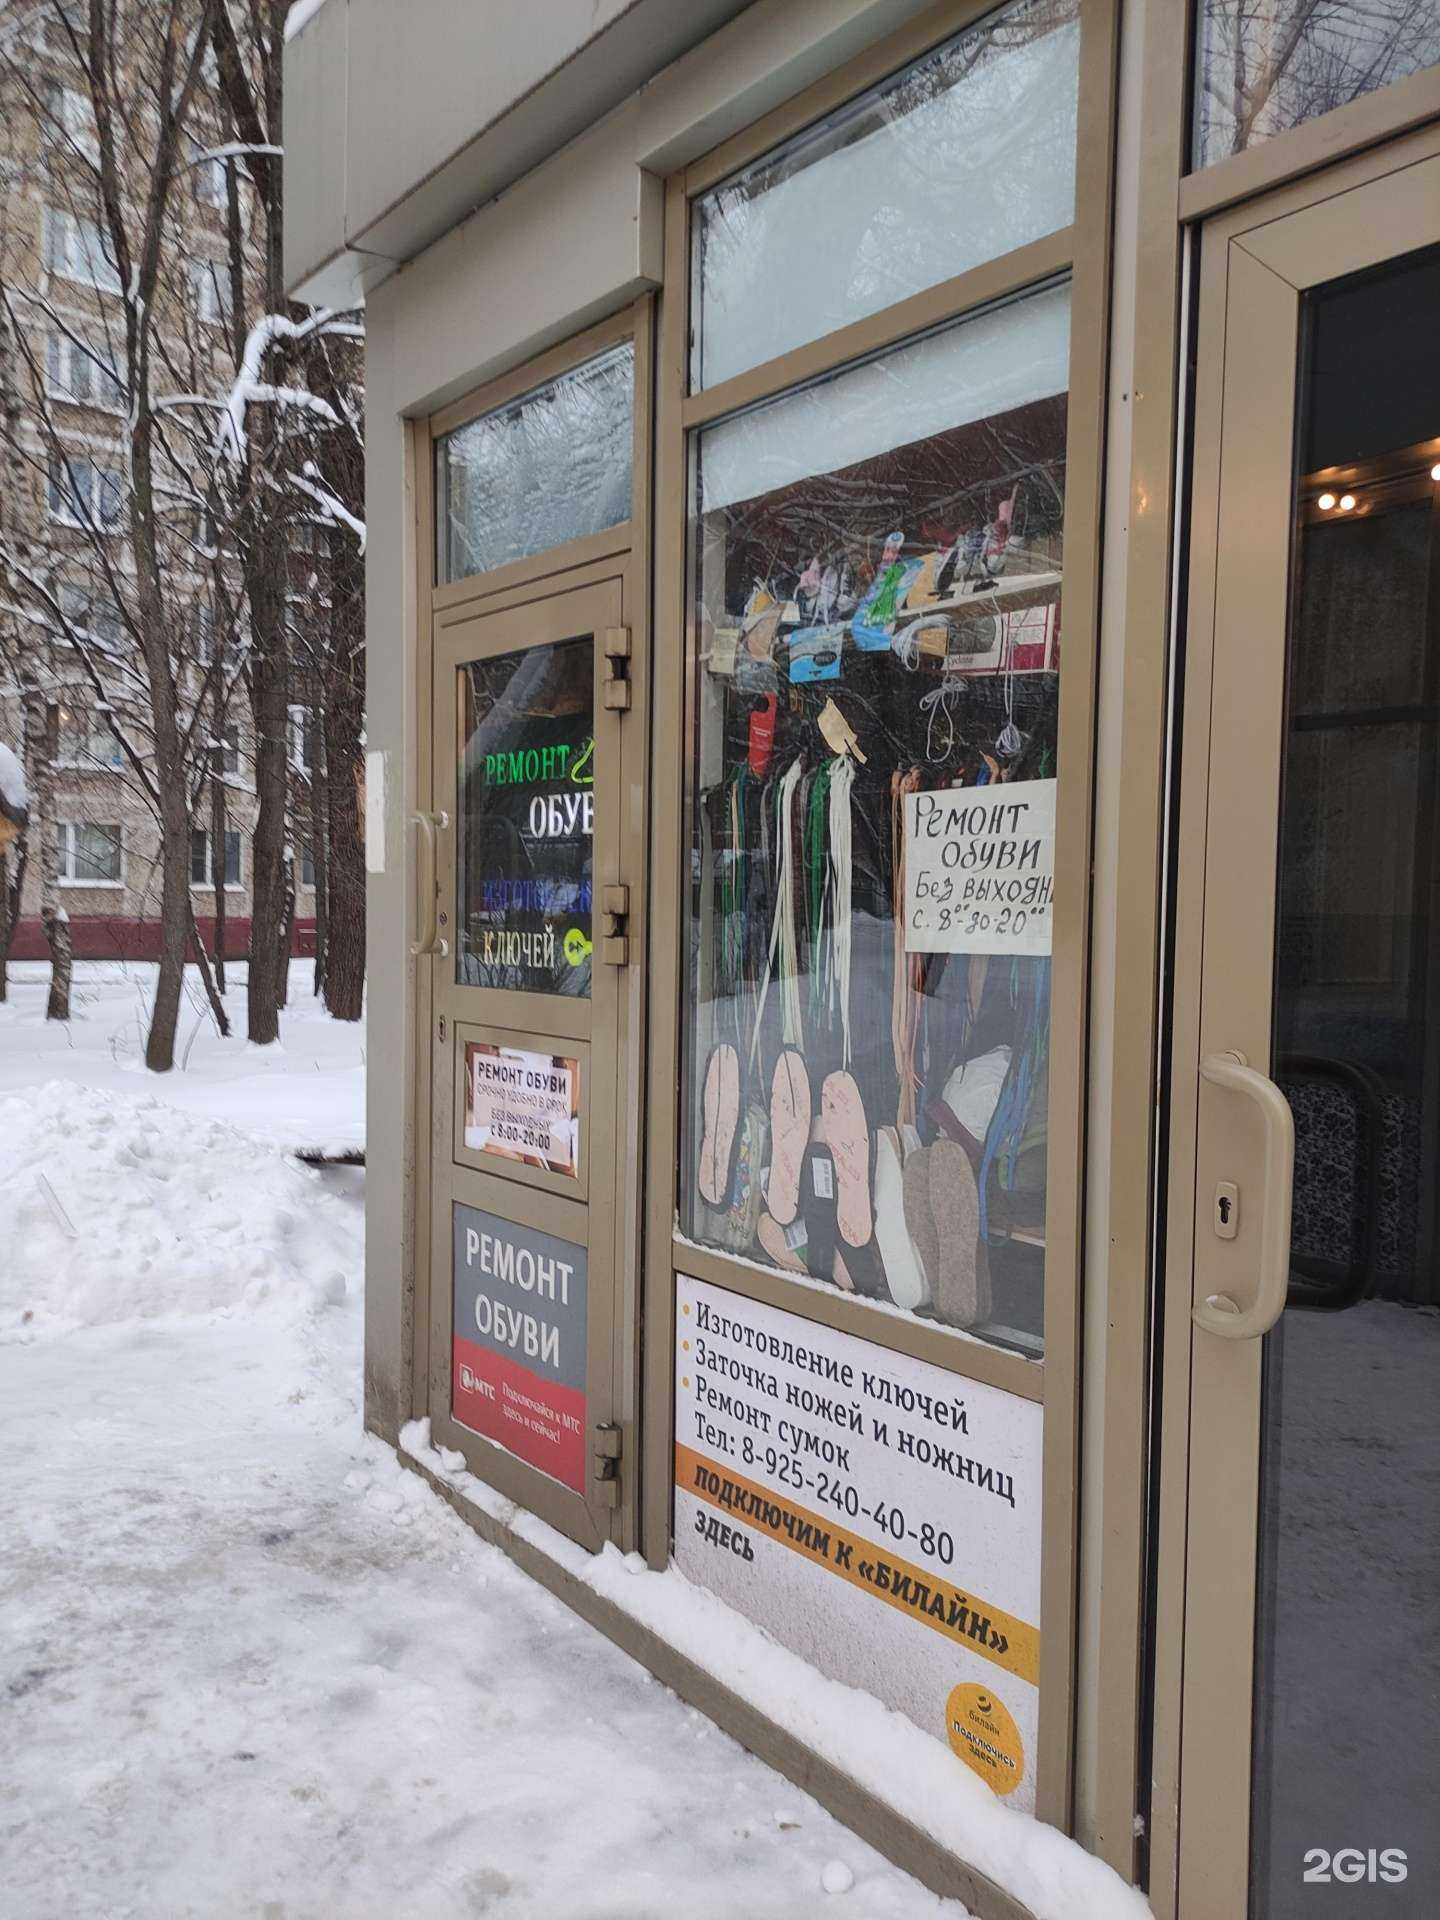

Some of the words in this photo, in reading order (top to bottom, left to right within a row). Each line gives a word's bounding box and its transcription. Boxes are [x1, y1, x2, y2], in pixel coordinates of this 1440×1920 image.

[484, 744, 571, 786] РЕМОНТ
[914, 794, 1030, 838] Ремонт
[915, 871, 954, 904] Без
[483, 922, 555, 968] КЛЮЧЕЙ
[478, 1061, 524, 1088] РЕМОНТ
[526, 1072, 567, 1095] ОБУВИ
[465, 1226, 575, 1306] РЕМОНТ
[474, 1293, 561, 1369] ОБУВИ
[474, 1376, 496, 1401] МТС
[695, 1300, 854, 1388] Изготовление
[861, 1371, 970, 1436] ключей
[562, 1411, 581, 1434] МТС
[695, 1338, 780, 1400] Заточка
[785, 1381, 865, 1436] ножей
[872, 1417, 890, 1448] и
[898, 1428, 1016, 1509] ножниц
[695, 1374, 773, 1435] Ремонт
[777, 1417, 851, 1473] сумок
[694, 1411, 736, 1454] Тел:
[741, 1436, 955, 1566] 8-925-240-40-80
[694, 1509, 755, 1563] ЗДЕСЬ
[694, 1463, 831, 1558] ПОДКЛЮЧИМ
[836, 1538, 854, 1571] К
[858, 1559, 1010, 1655] «БИЛАЙН»
[953, 1719, 1016, 1769] Подключись
[968, 1709, 1000, 1737] билайн
